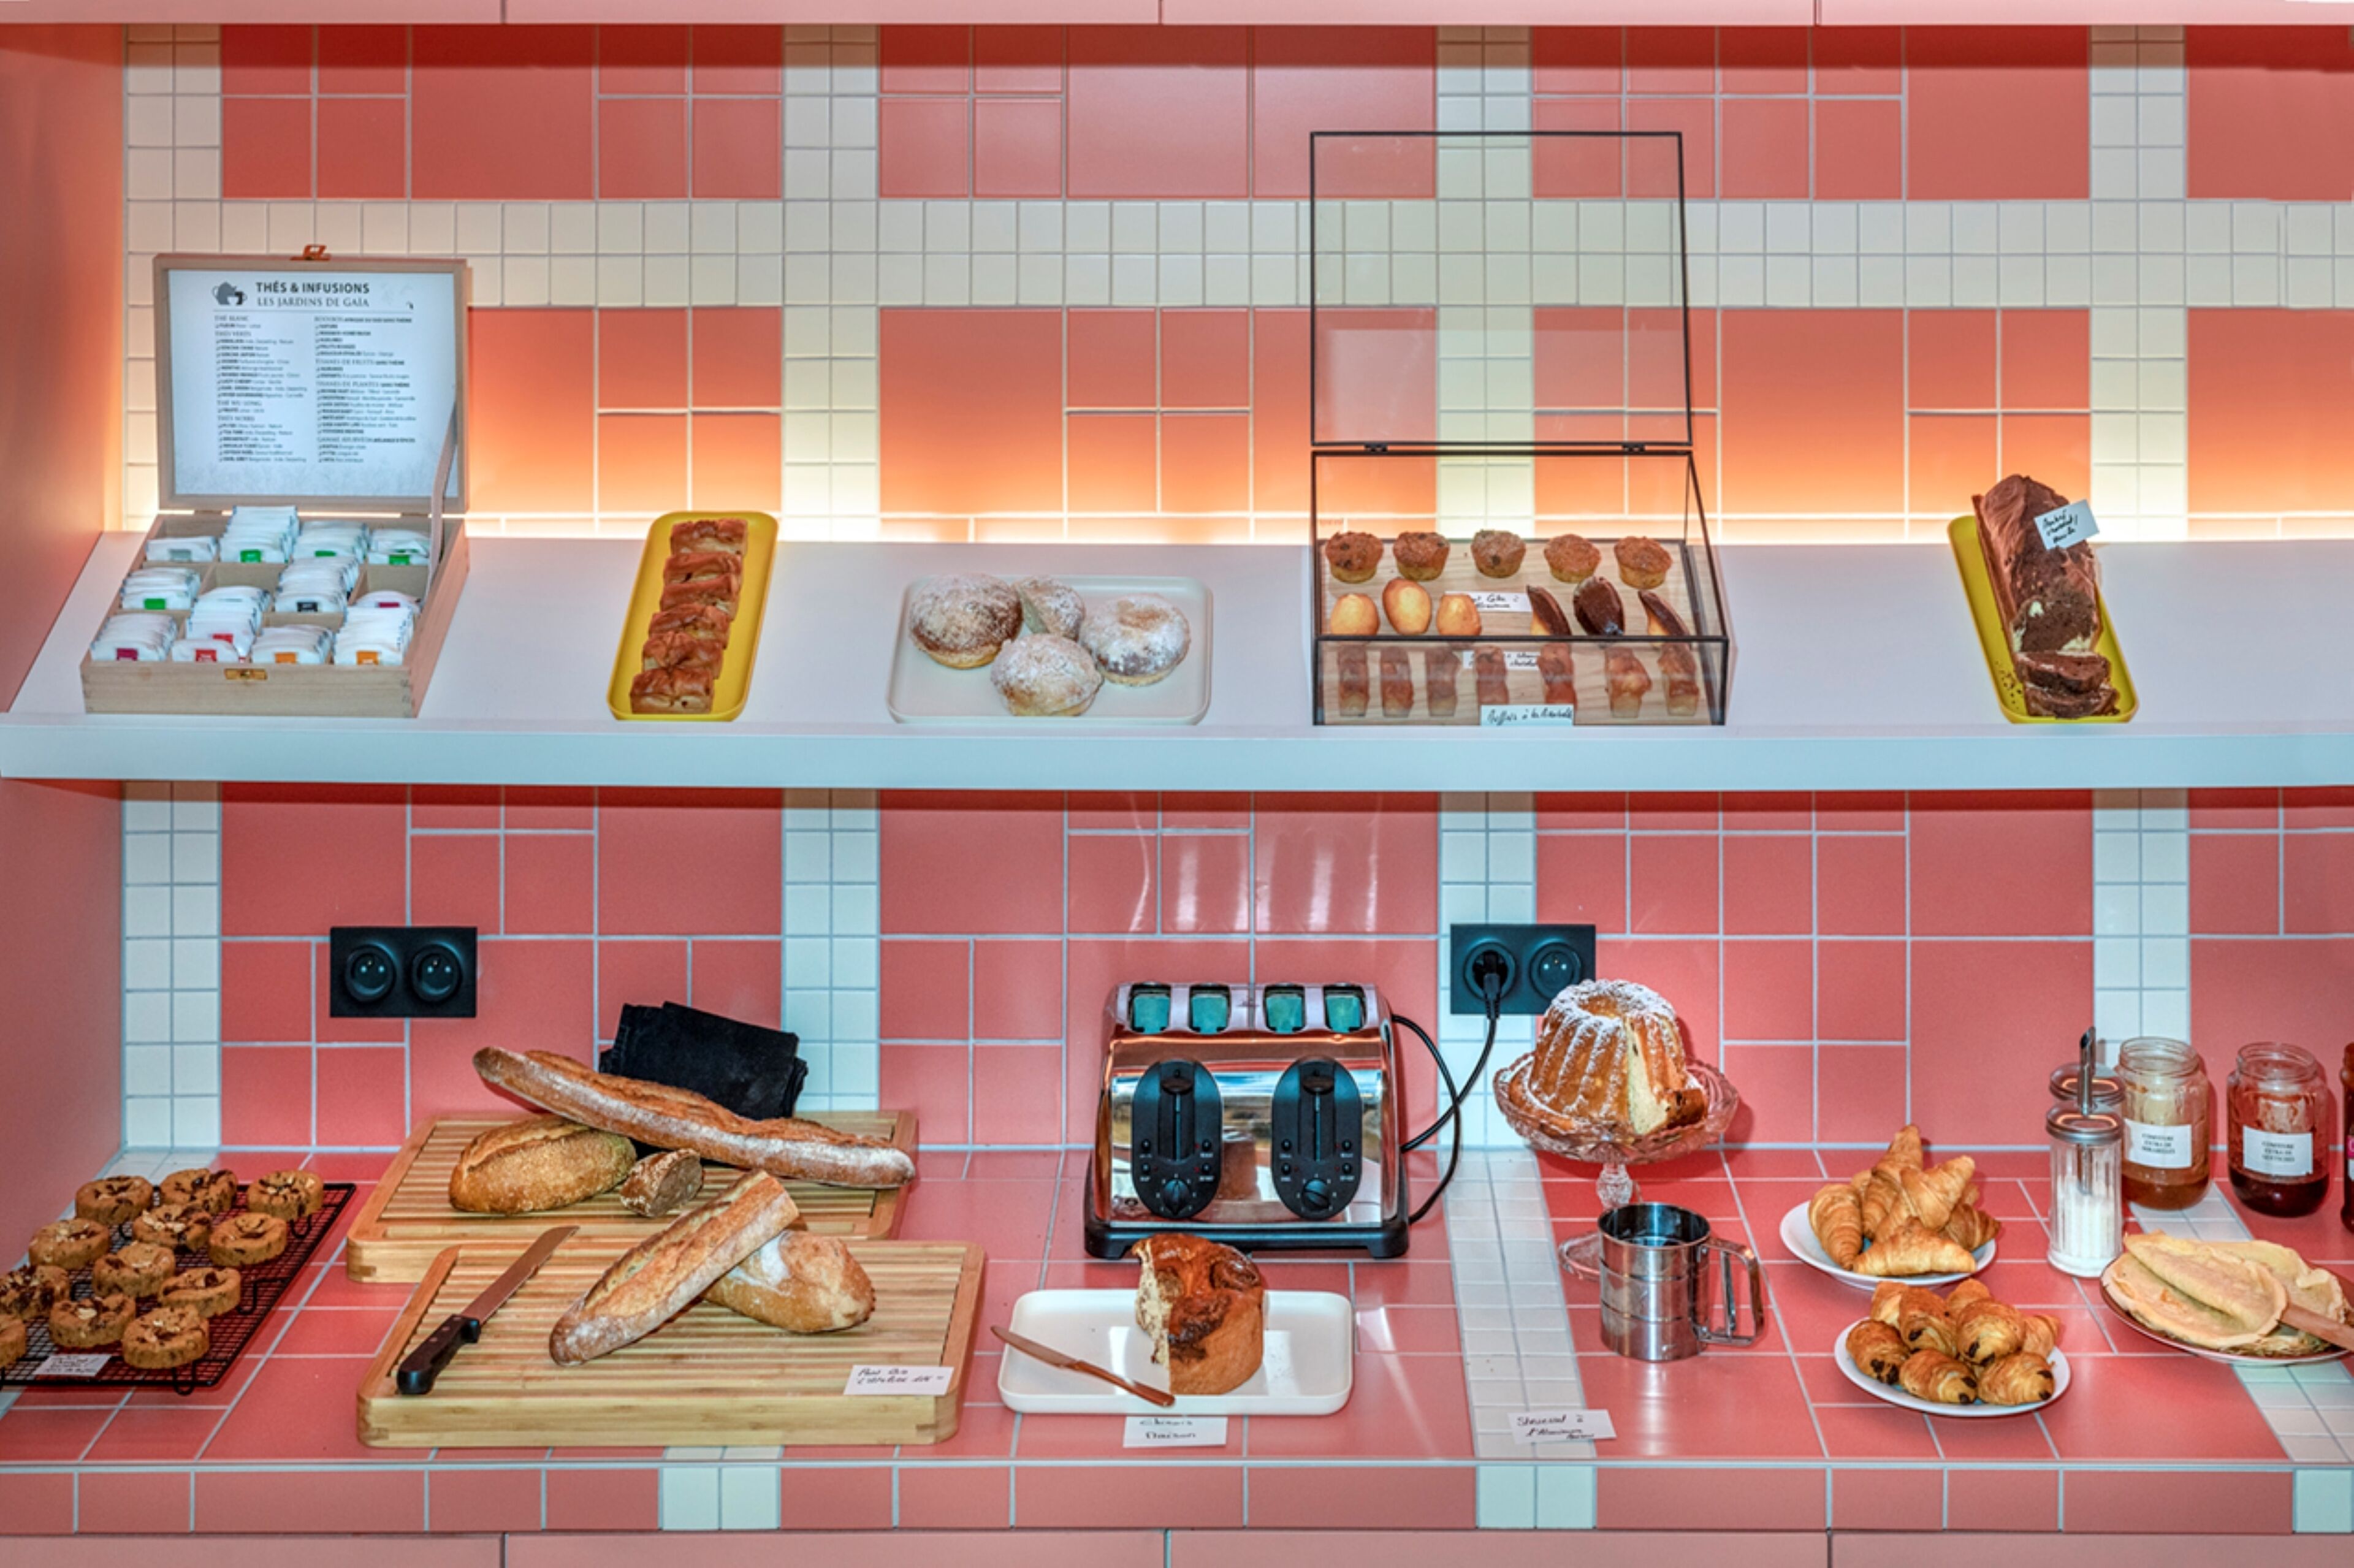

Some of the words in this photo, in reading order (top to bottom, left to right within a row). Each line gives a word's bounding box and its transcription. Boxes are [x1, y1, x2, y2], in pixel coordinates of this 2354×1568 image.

[256, 281, 287, 293] THÉS
[290, 283, 299, 293] &
[302, 282, 370, 294] INFUSIONS
[257, 297, 274, 306] LES
[277, 297, 322, 307] JARDINS
[326, 297, 339, 306] DE
